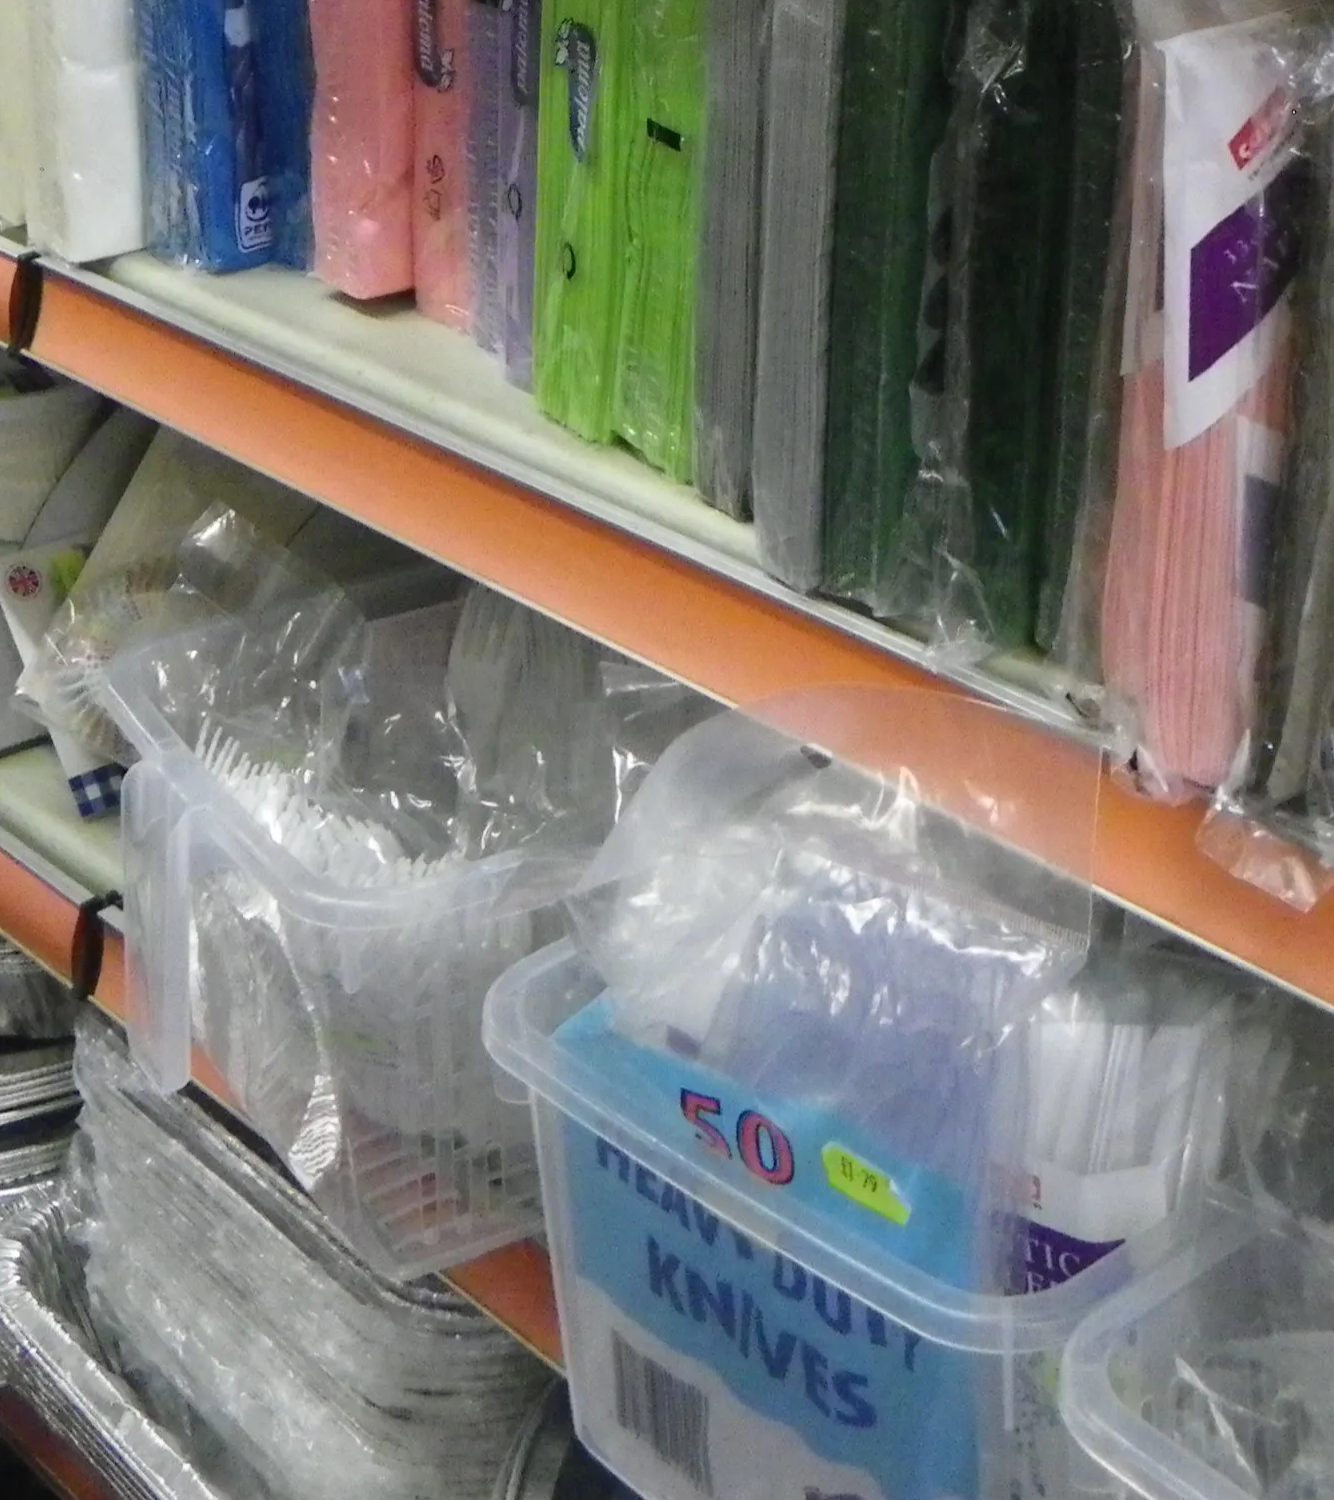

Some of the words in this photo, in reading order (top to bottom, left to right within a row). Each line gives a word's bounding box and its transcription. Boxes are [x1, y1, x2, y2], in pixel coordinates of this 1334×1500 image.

[574, 40, 593, 153] paloma
[679, 1087, 796, 1185] 50
[647, 1233, 877, 1429] KNIVES
